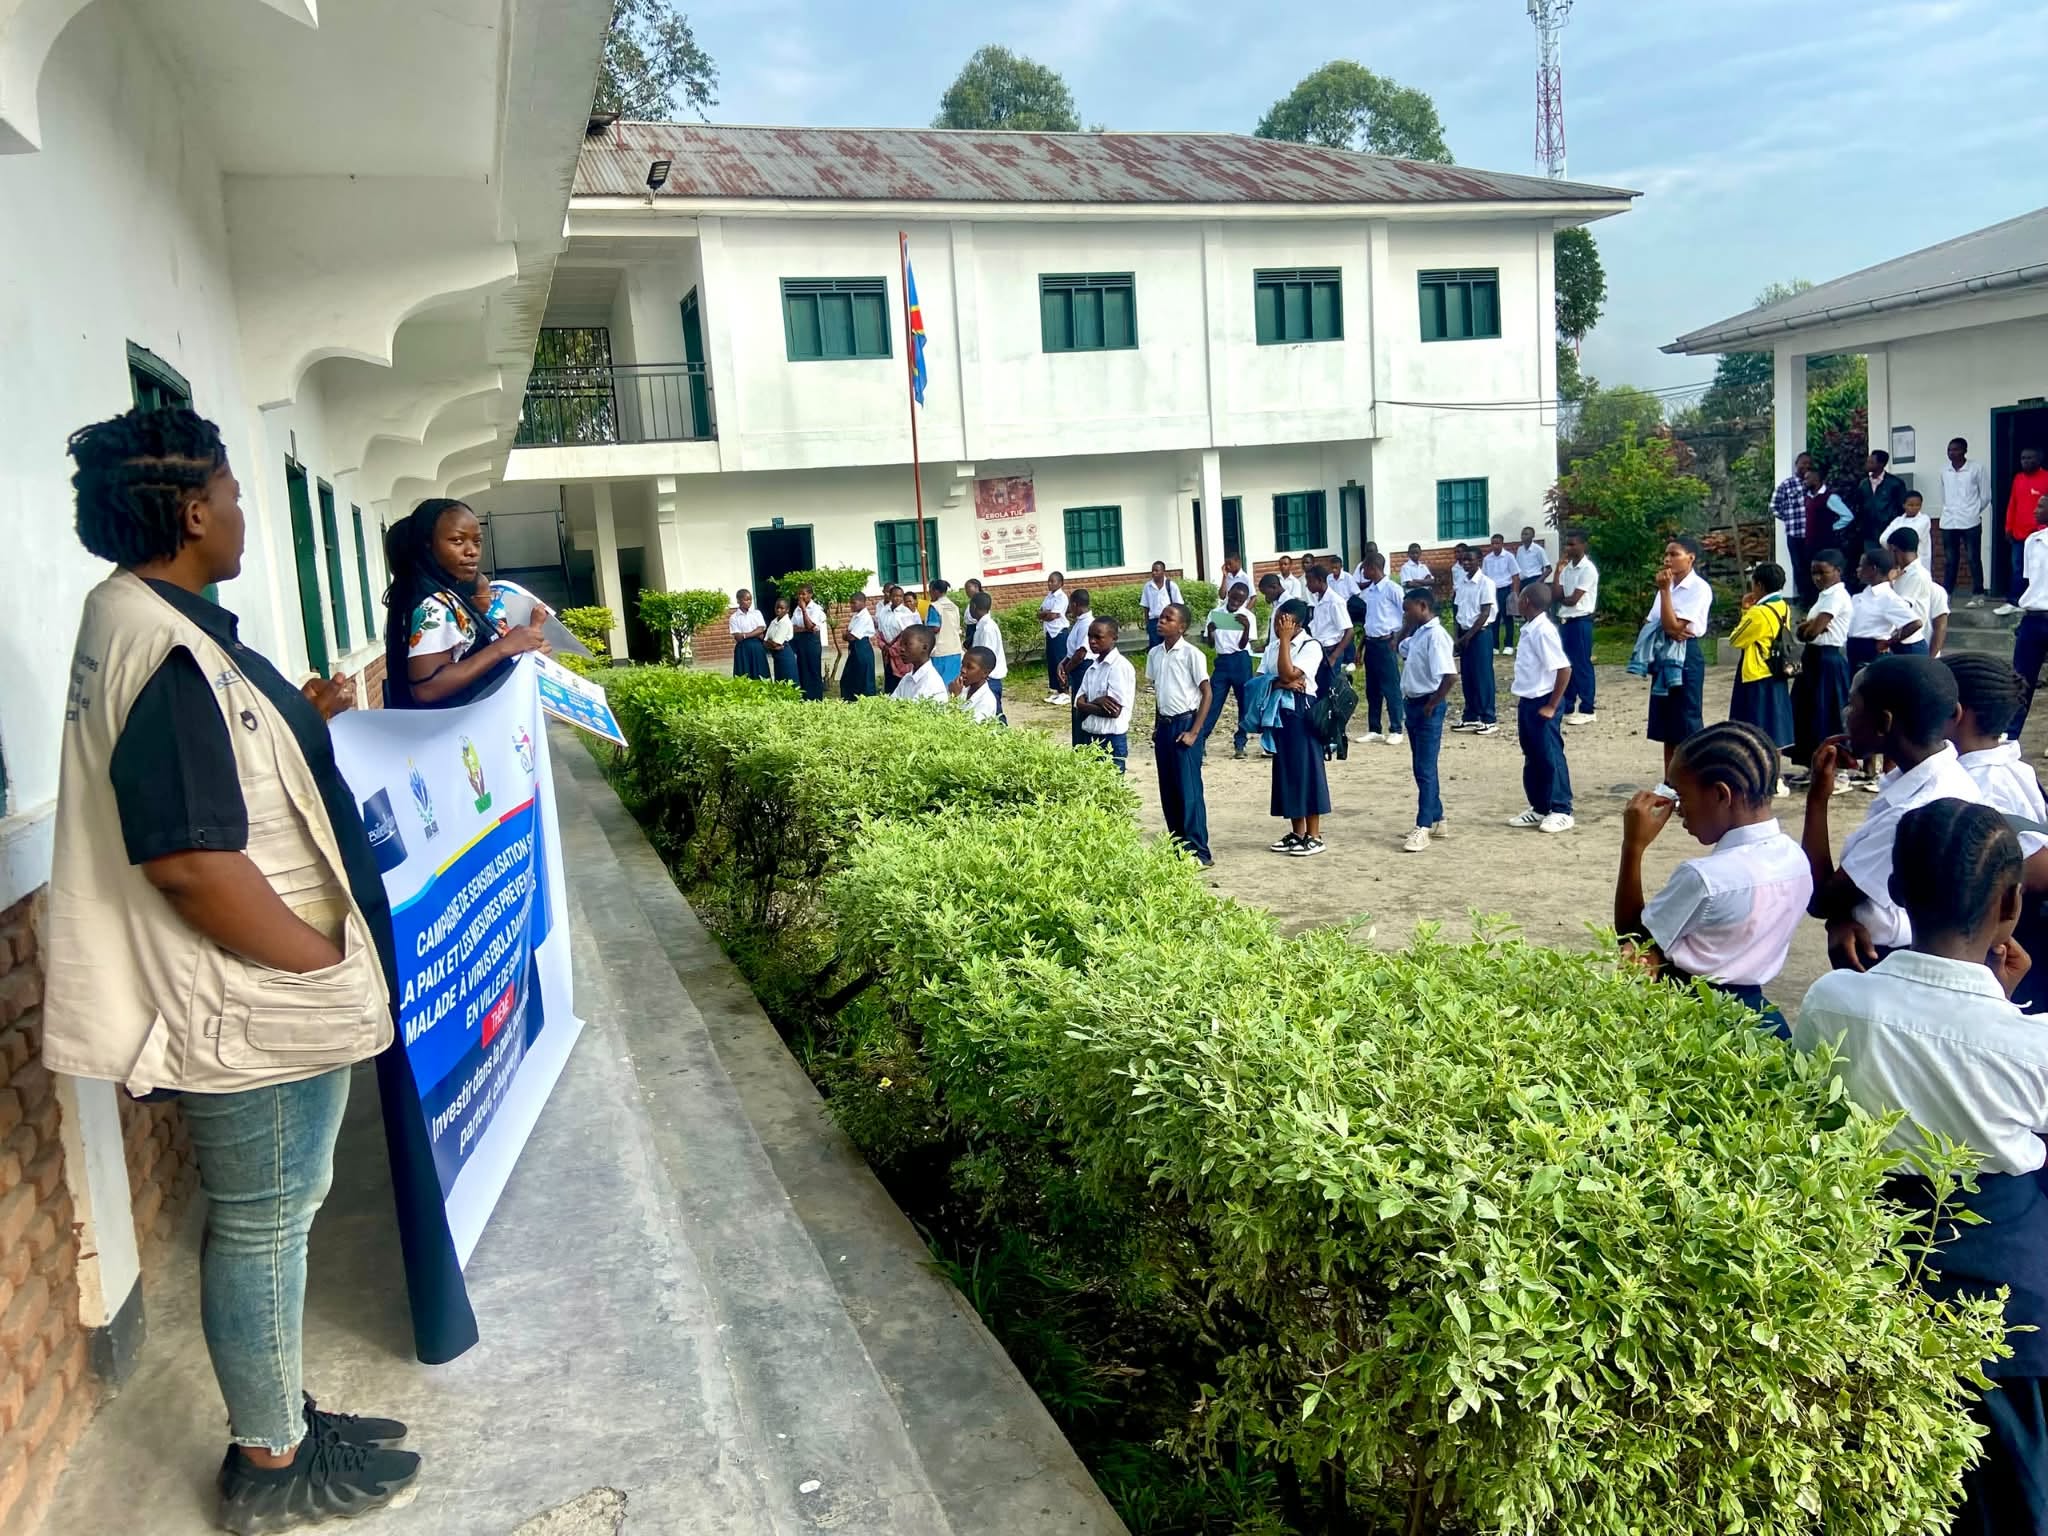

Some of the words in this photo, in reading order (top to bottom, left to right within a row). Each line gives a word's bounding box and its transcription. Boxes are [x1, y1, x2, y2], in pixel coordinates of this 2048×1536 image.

[985, 511, 1009, 519] EBOLA
[416, 896, 462, 957] CAMPAGNE
[458, 886, 471, 914] DE
[467, 837, 529, 903] SENSIBILISATION
[417, 955, 446, 998] PAIX
[446, 944, 459, 976] ET
[459, 930, 474, 962] LES
[469, 896, 502, 946] MESURES
[405, 983, 457, 1048] MALADE
[459, 971, 467, 1001] À
[467, 949, 492, 991] VIRUS
[489, 924, 514, 966] EBOLA
[466, 998, 479, 1031] EN
[480, 972, 502, 1014] VILLE
[500, 960, 510, 989] DE
[432, 1078, 473, 1144] Investir
[472, 1055, 494, 1096] dans
[492, 1043, 500, 1067] la
